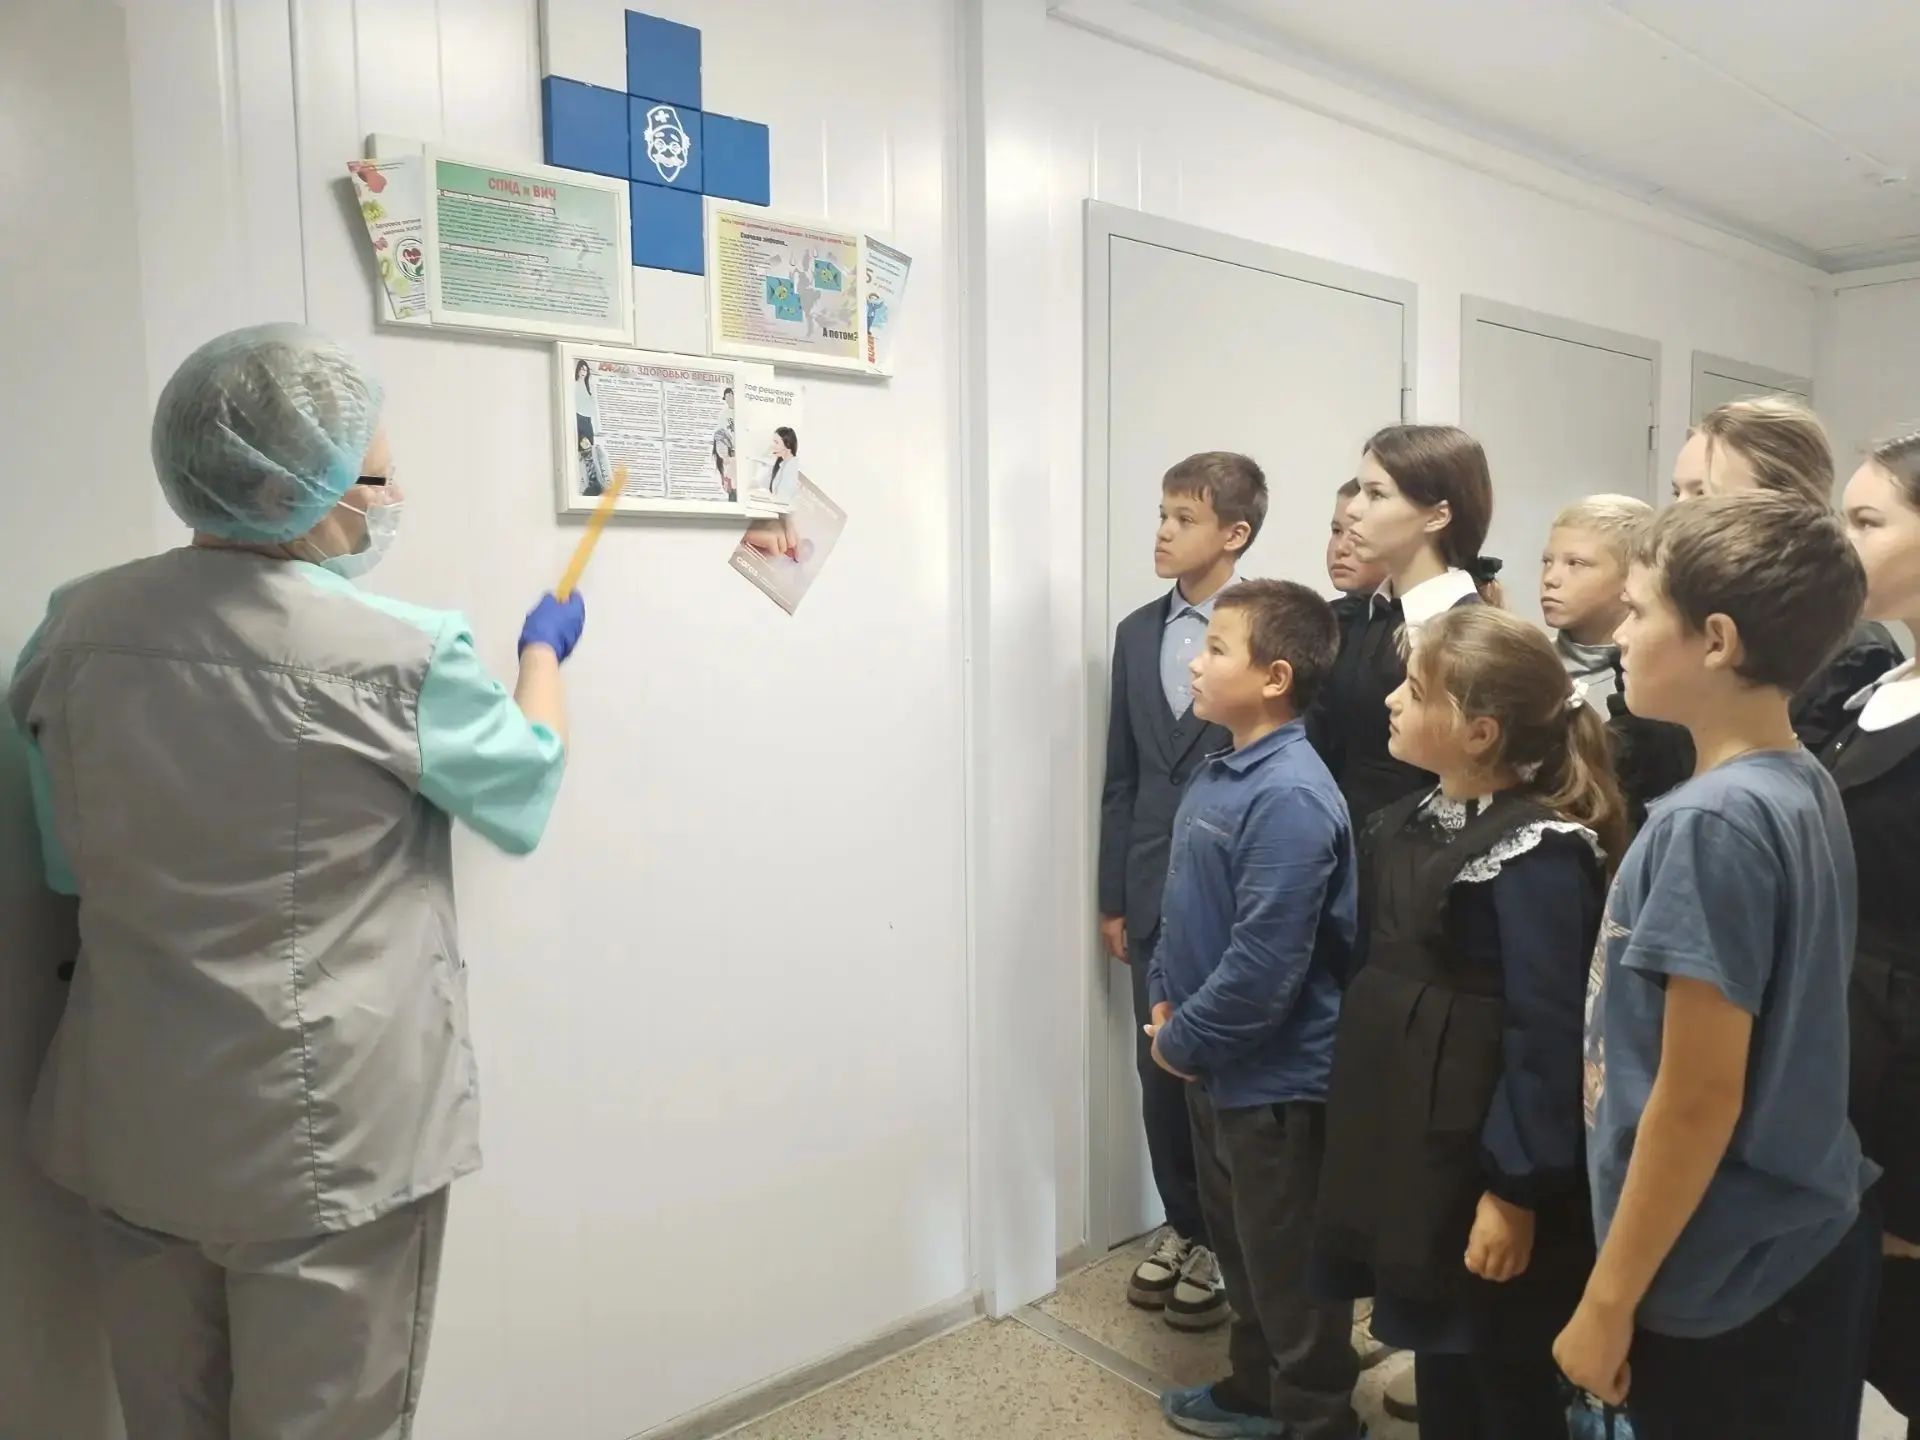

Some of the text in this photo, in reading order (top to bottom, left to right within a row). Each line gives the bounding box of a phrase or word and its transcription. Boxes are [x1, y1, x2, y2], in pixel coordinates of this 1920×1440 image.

[488, 177, 521, 197] СПИД
[533, 185, 557, 200] ВИЧ
[822, 327, 828, 338] А
[828, 331, 859, 342] потом?
[637, 367, 690, 380] ЗДОРОВЬЮ
[758, 386, 795, 398] решение
